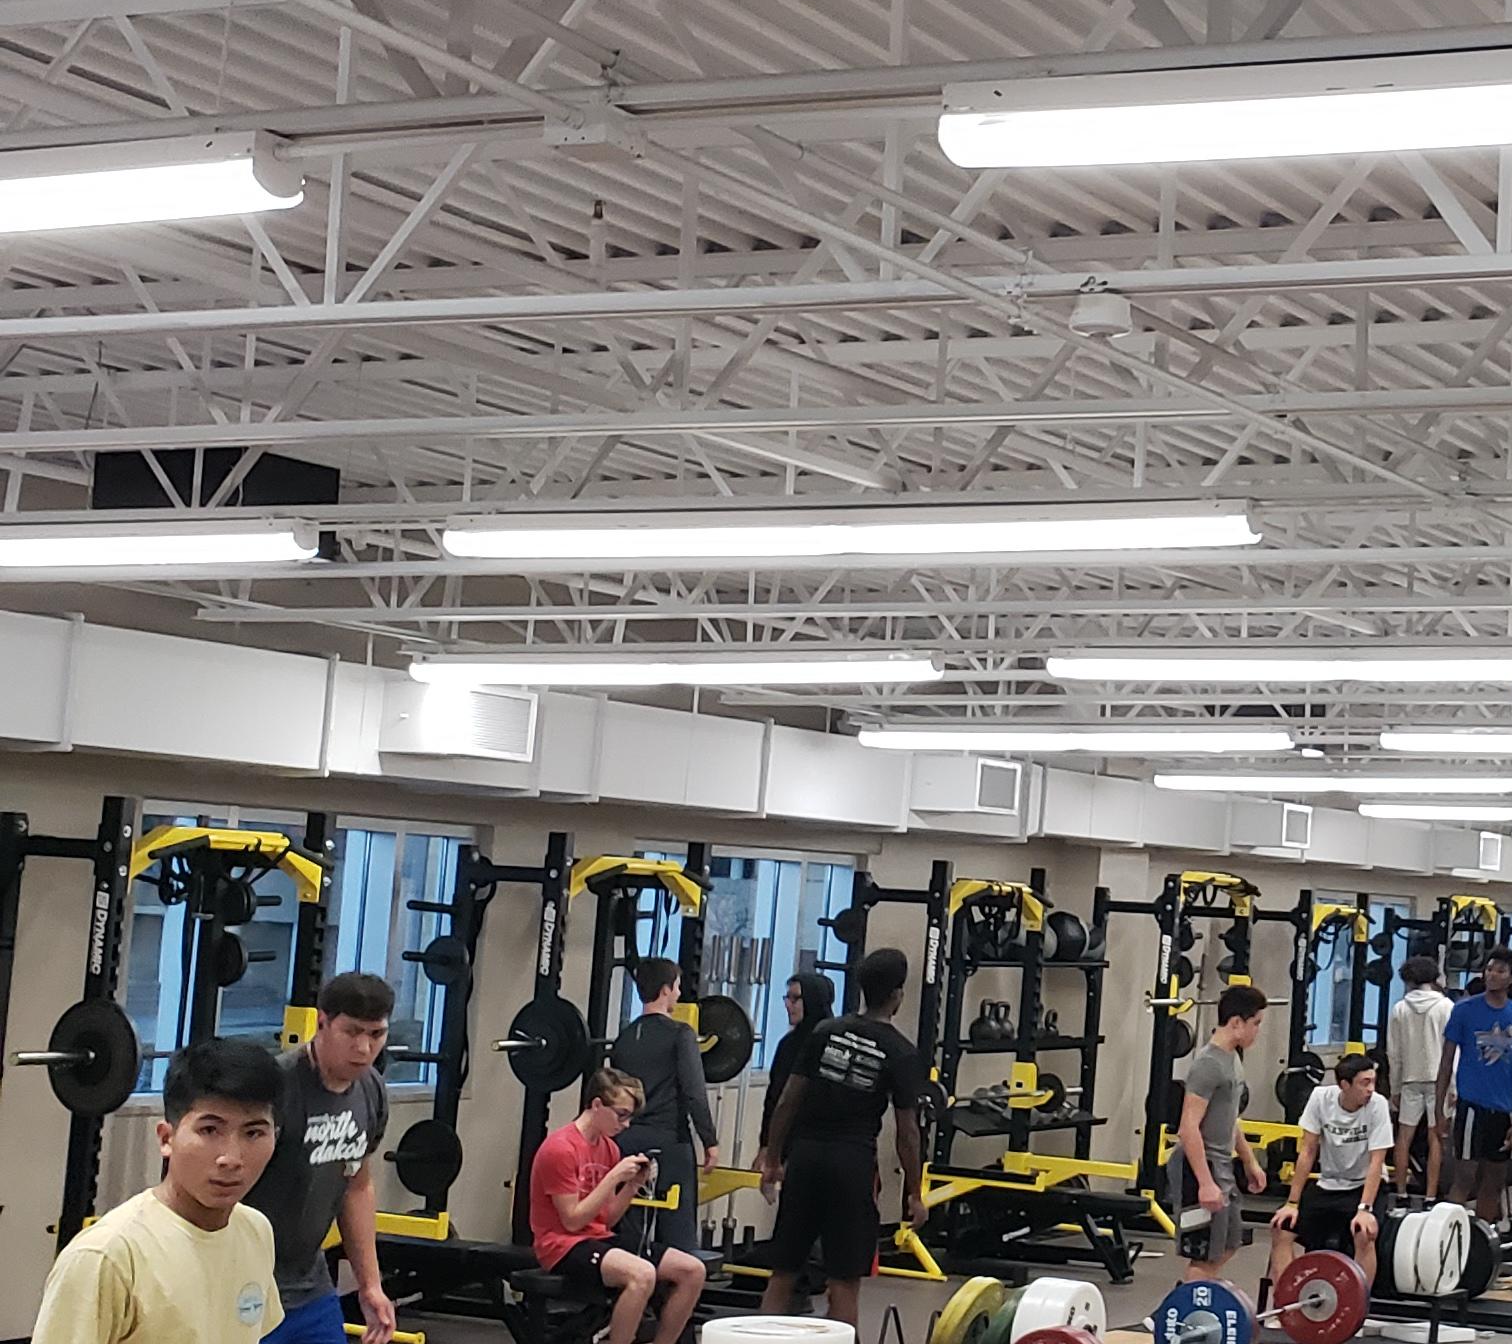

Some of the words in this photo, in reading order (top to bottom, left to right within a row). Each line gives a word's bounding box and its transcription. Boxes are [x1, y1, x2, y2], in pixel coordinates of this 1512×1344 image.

[91, 909, 108, 975] DYNAMIC
[303, 1110, 358, 1144] north
[1196, 1286, 1209, 1307] 20
